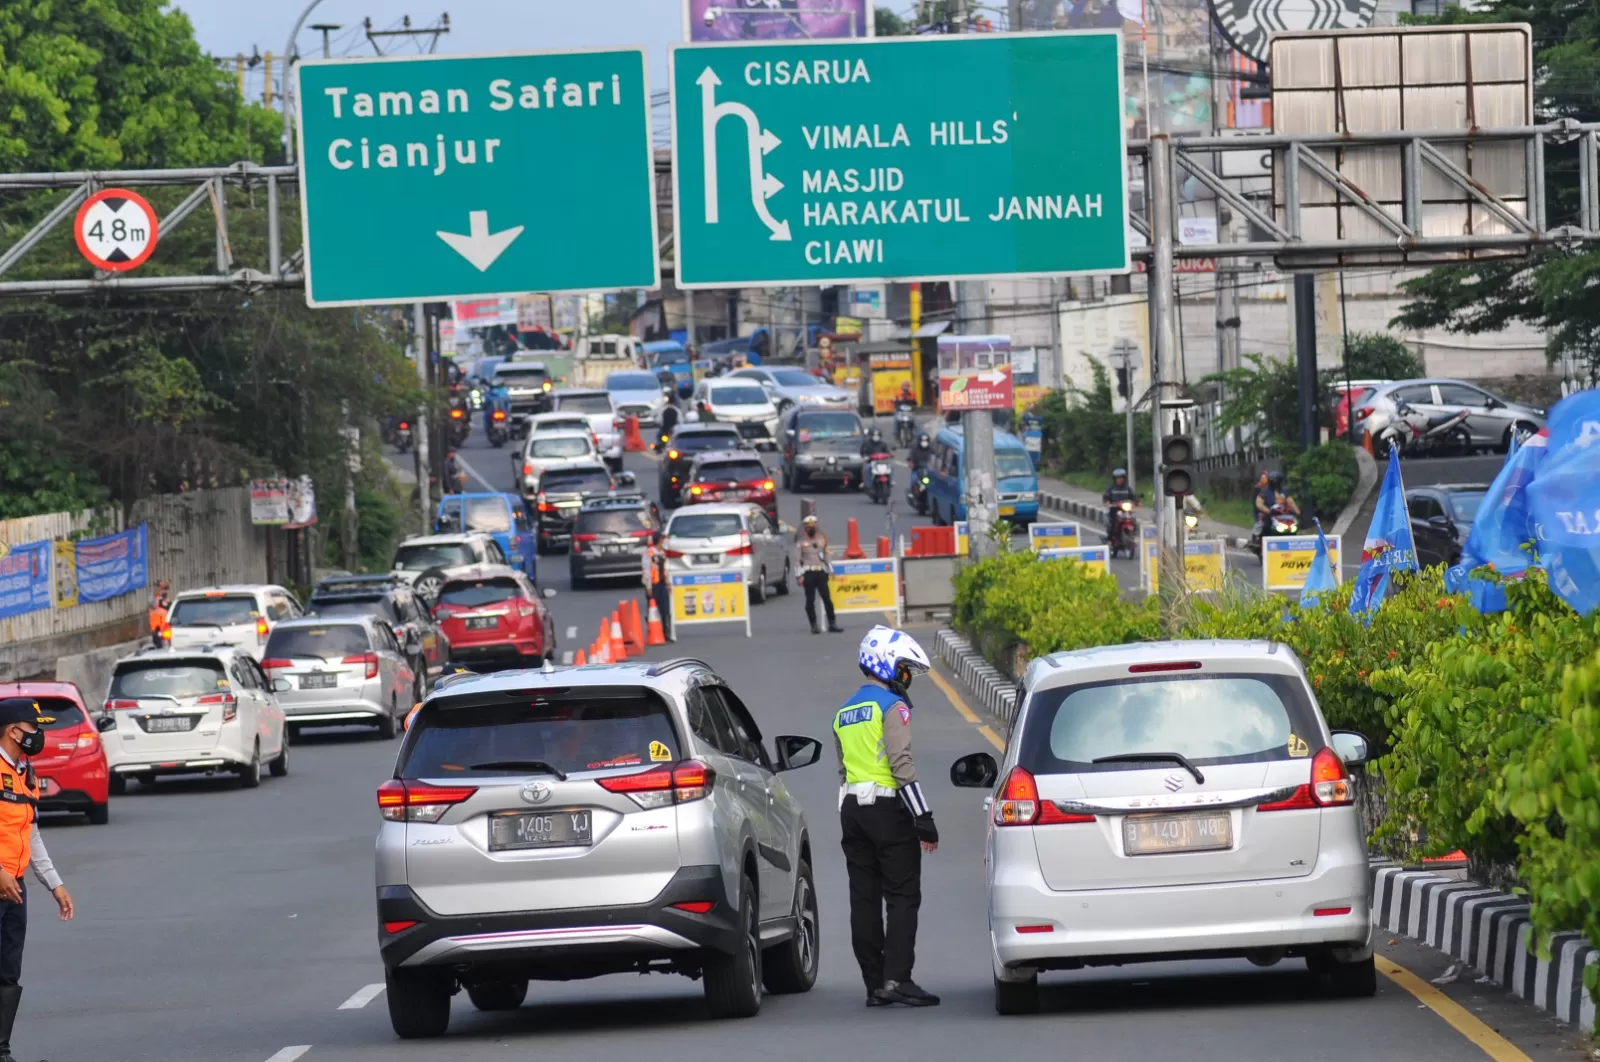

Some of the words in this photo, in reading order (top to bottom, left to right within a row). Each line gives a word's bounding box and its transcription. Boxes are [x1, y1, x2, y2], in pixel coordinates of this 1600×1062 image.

[744, 59, 871, 86] CISARUA
[324, 87, 469, 118] Taman
[489, 74, 621, 111] Safari
[802, 123, 911, 150] VIMALA
[930, 120, 1008, 146] HILLS
[328, 134, 501, 176] Cianjur
[802, 168, 904, 194] MASJID
[803, 198, 970, 227] HARAKATUL
[988, 194, 1103, 222] JANNAH
[805, 239, 884, 265] CIAWI
[836, 583, 878, 592] POWER
[518, 815, 553, 835] 1405
[570, 814, 588, 831] YJ
[1127, 824, 1137, 841] B
